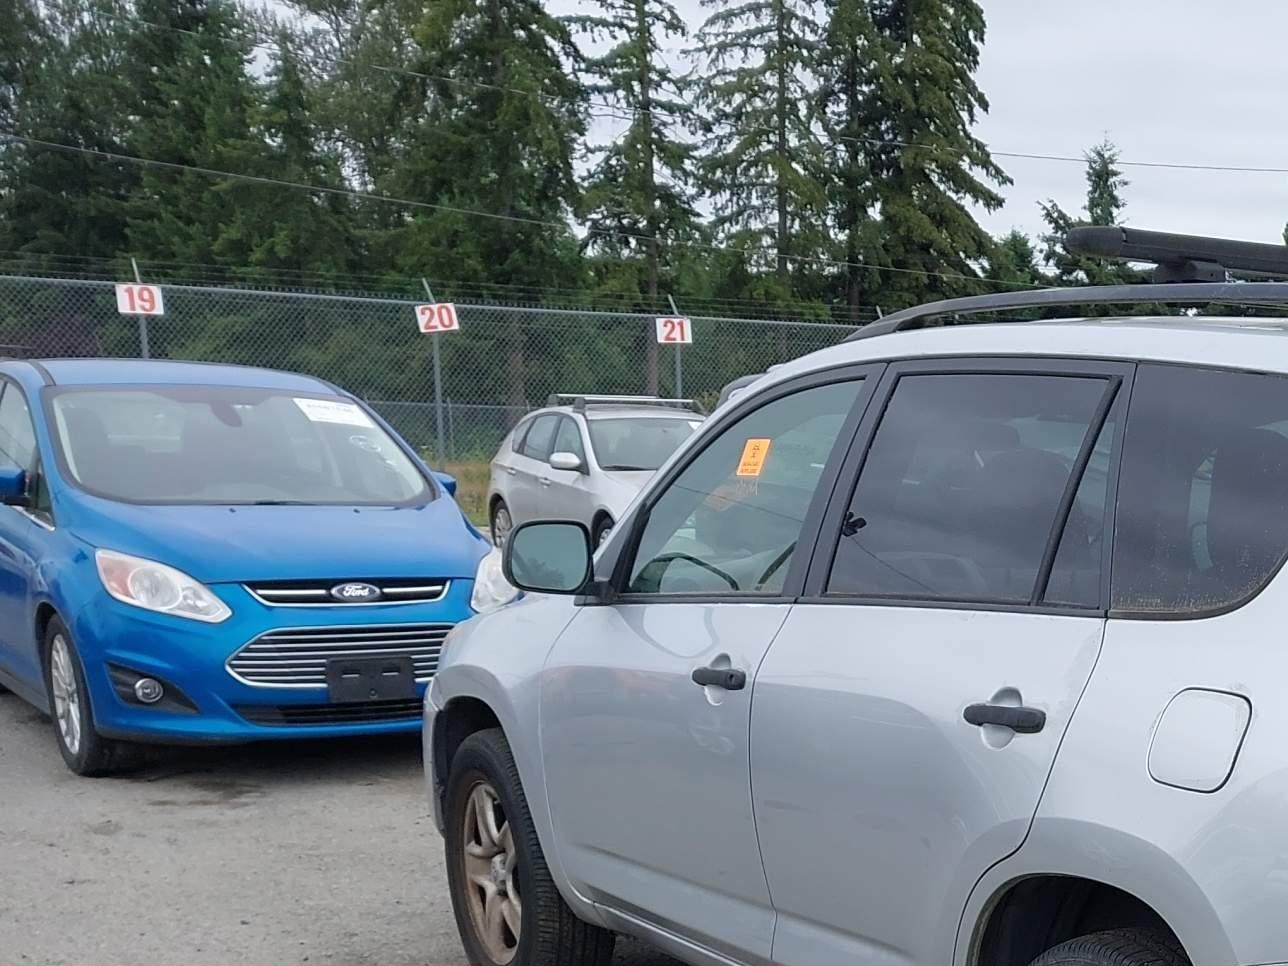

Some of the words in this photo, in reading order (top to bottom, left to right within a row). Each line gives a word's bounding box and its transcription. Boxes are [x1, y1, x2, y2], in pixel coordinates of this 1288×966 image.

[124, 286, 156, 312] 19
[420, 305, 454, 330] 20
[663, 320, 685, 341] 21
[342, 585, 369, 597] Ford
